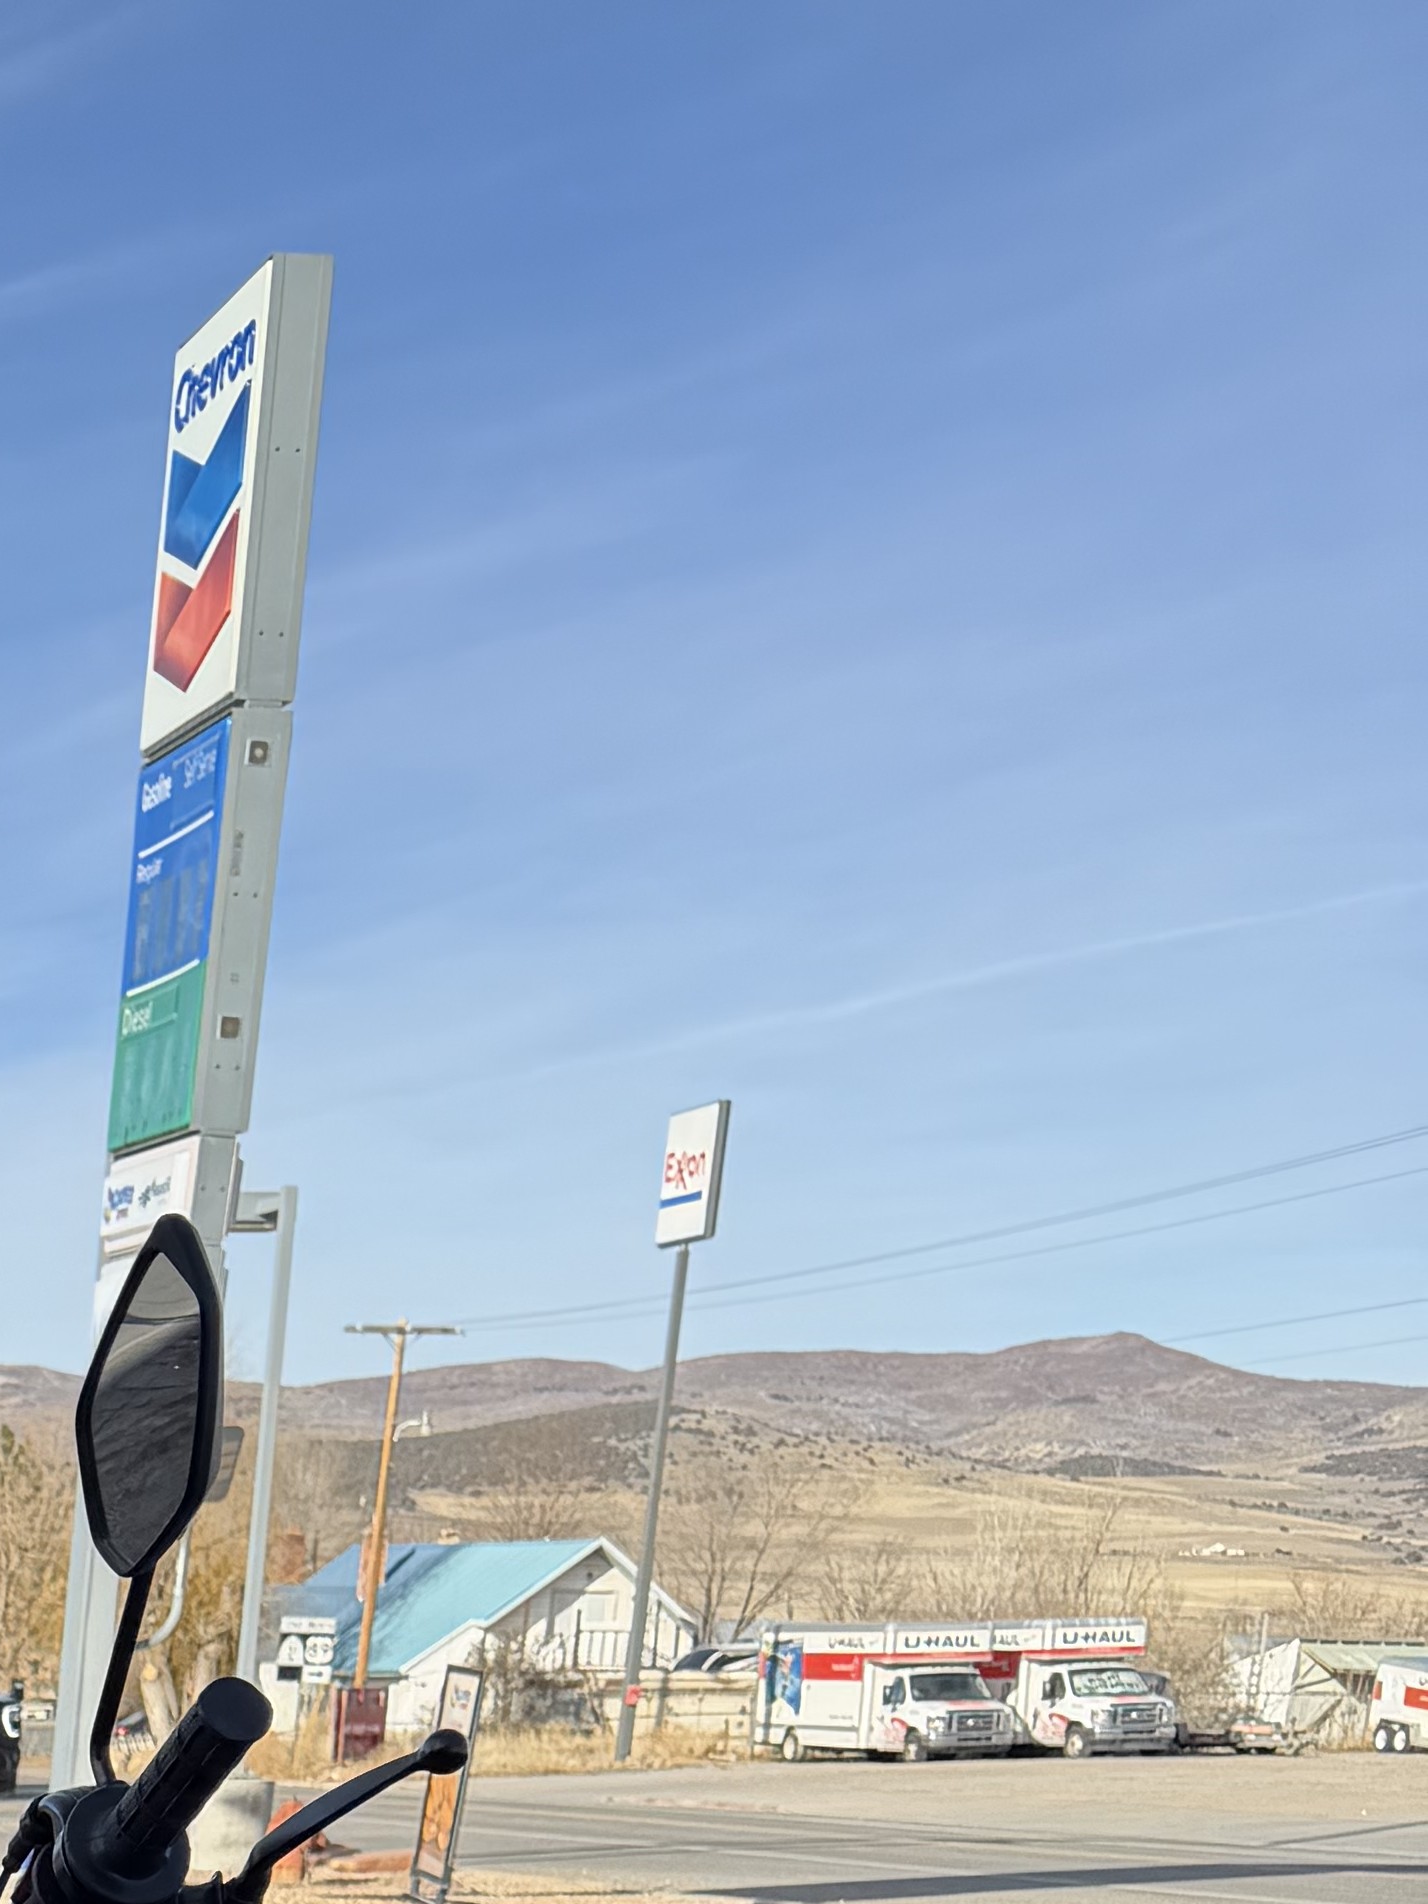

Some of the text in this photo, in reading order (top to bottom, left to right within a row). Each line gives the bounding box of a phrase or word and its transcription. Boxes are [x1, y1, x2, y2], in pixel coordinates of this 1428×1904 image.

[174, 318, 256, 434] Chevron
[121, 1001, 154, 1039] Diesel
[664, 1150, 706, 1190] Exxon
[904, 1635, 981, 1649] U-HAUL
[1062, 1629, 1136, 1645] U-HAUL
